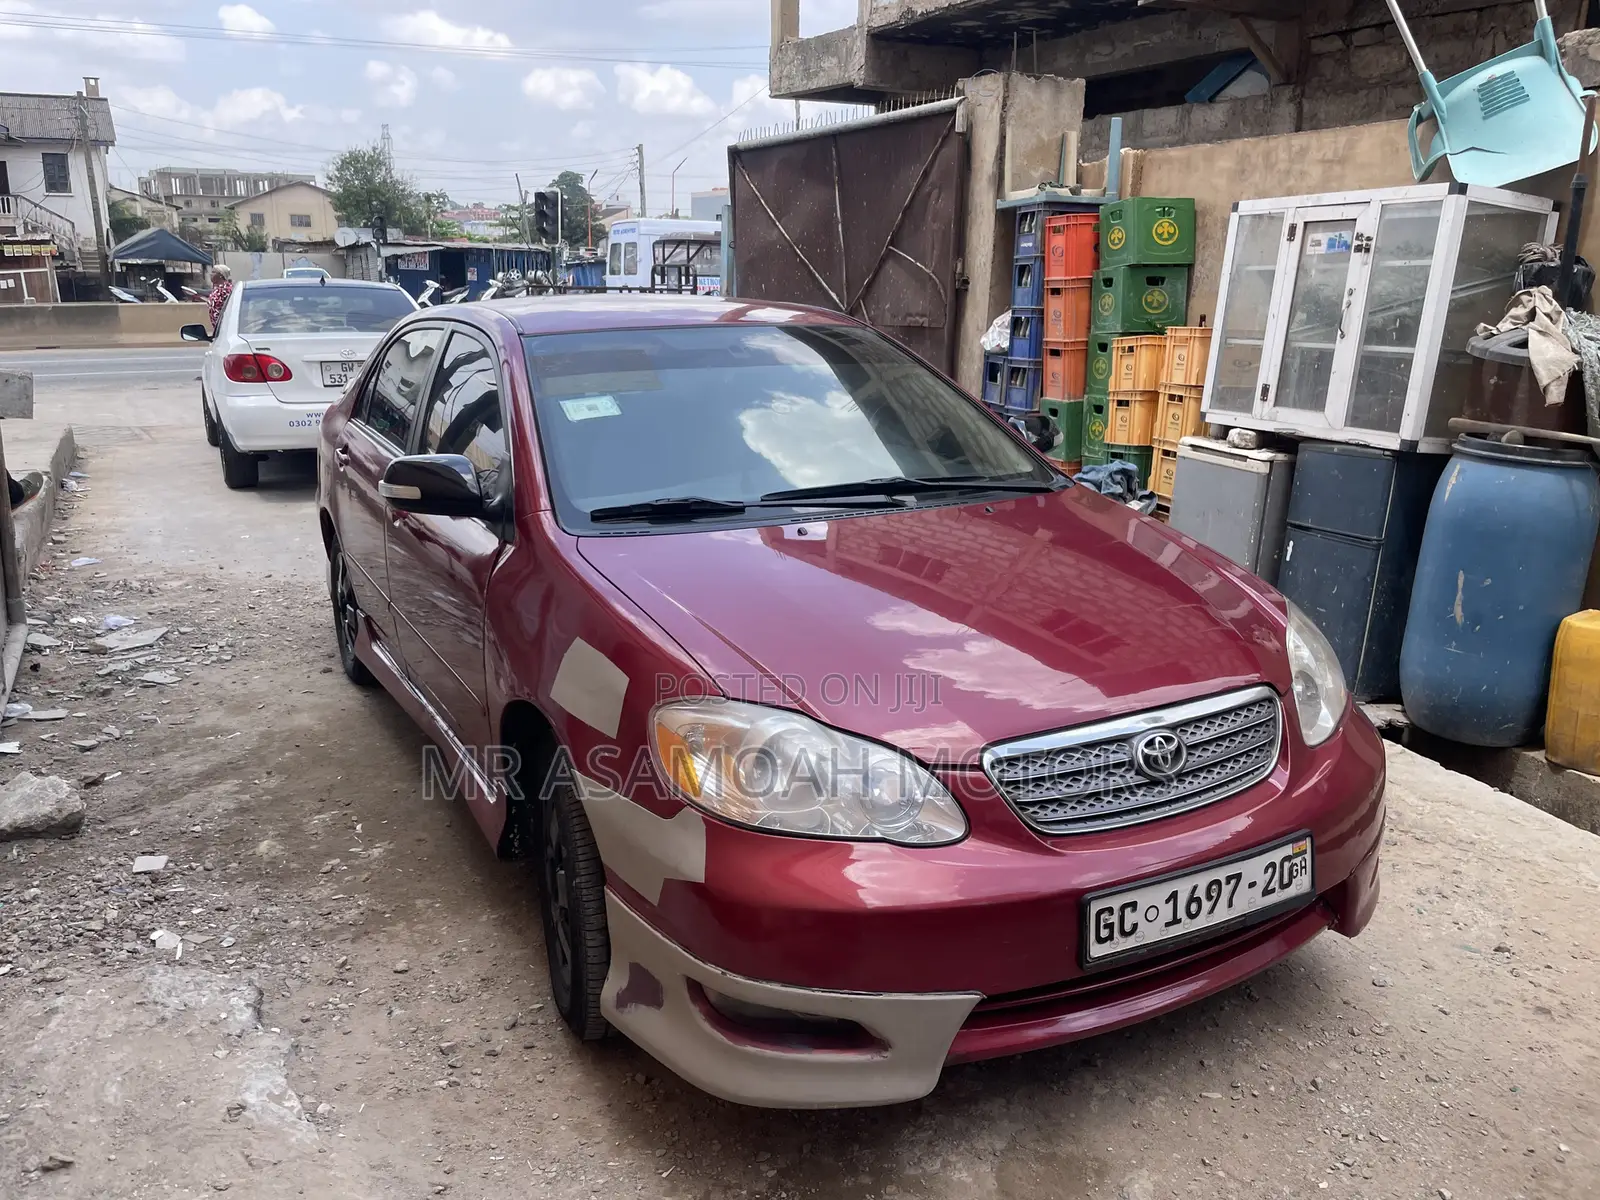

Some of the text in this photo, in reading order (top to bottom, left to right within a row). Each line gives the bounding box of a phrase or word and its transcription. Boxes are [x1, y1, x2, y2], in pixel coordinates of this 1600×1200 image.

[341, 362, 354, 372] GW
[1095, 855, 1308, 944] GC 1697-20 GH
